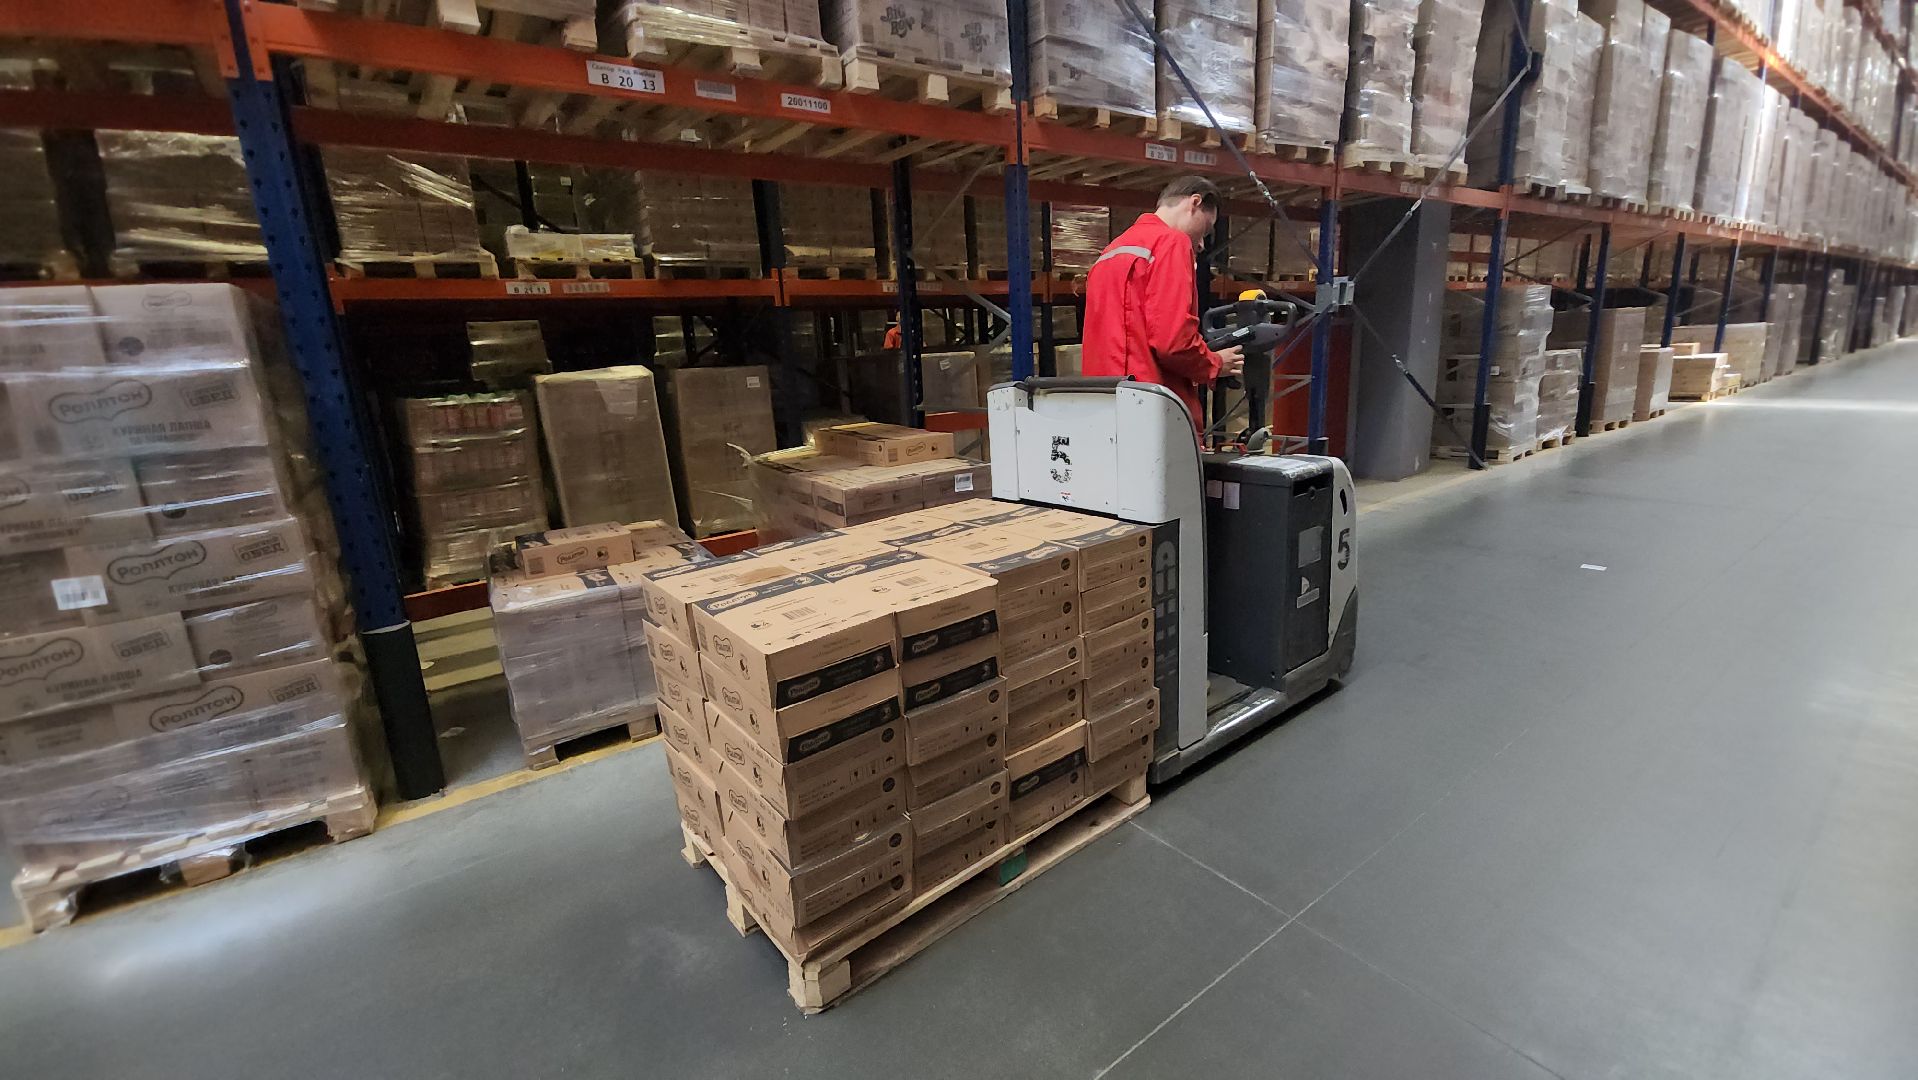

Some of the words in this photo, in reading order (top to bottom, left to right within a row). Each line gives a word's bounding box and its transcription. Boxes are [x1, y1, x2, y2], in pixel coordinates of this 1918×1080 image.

[619, 76, 633, 88] 20
[643, 80, 656, 91] 13
[787, 96, 828, 110] 20011100
[1050, 435, 1073, 484] 5
[1337, 527, 1351, 571] 5
